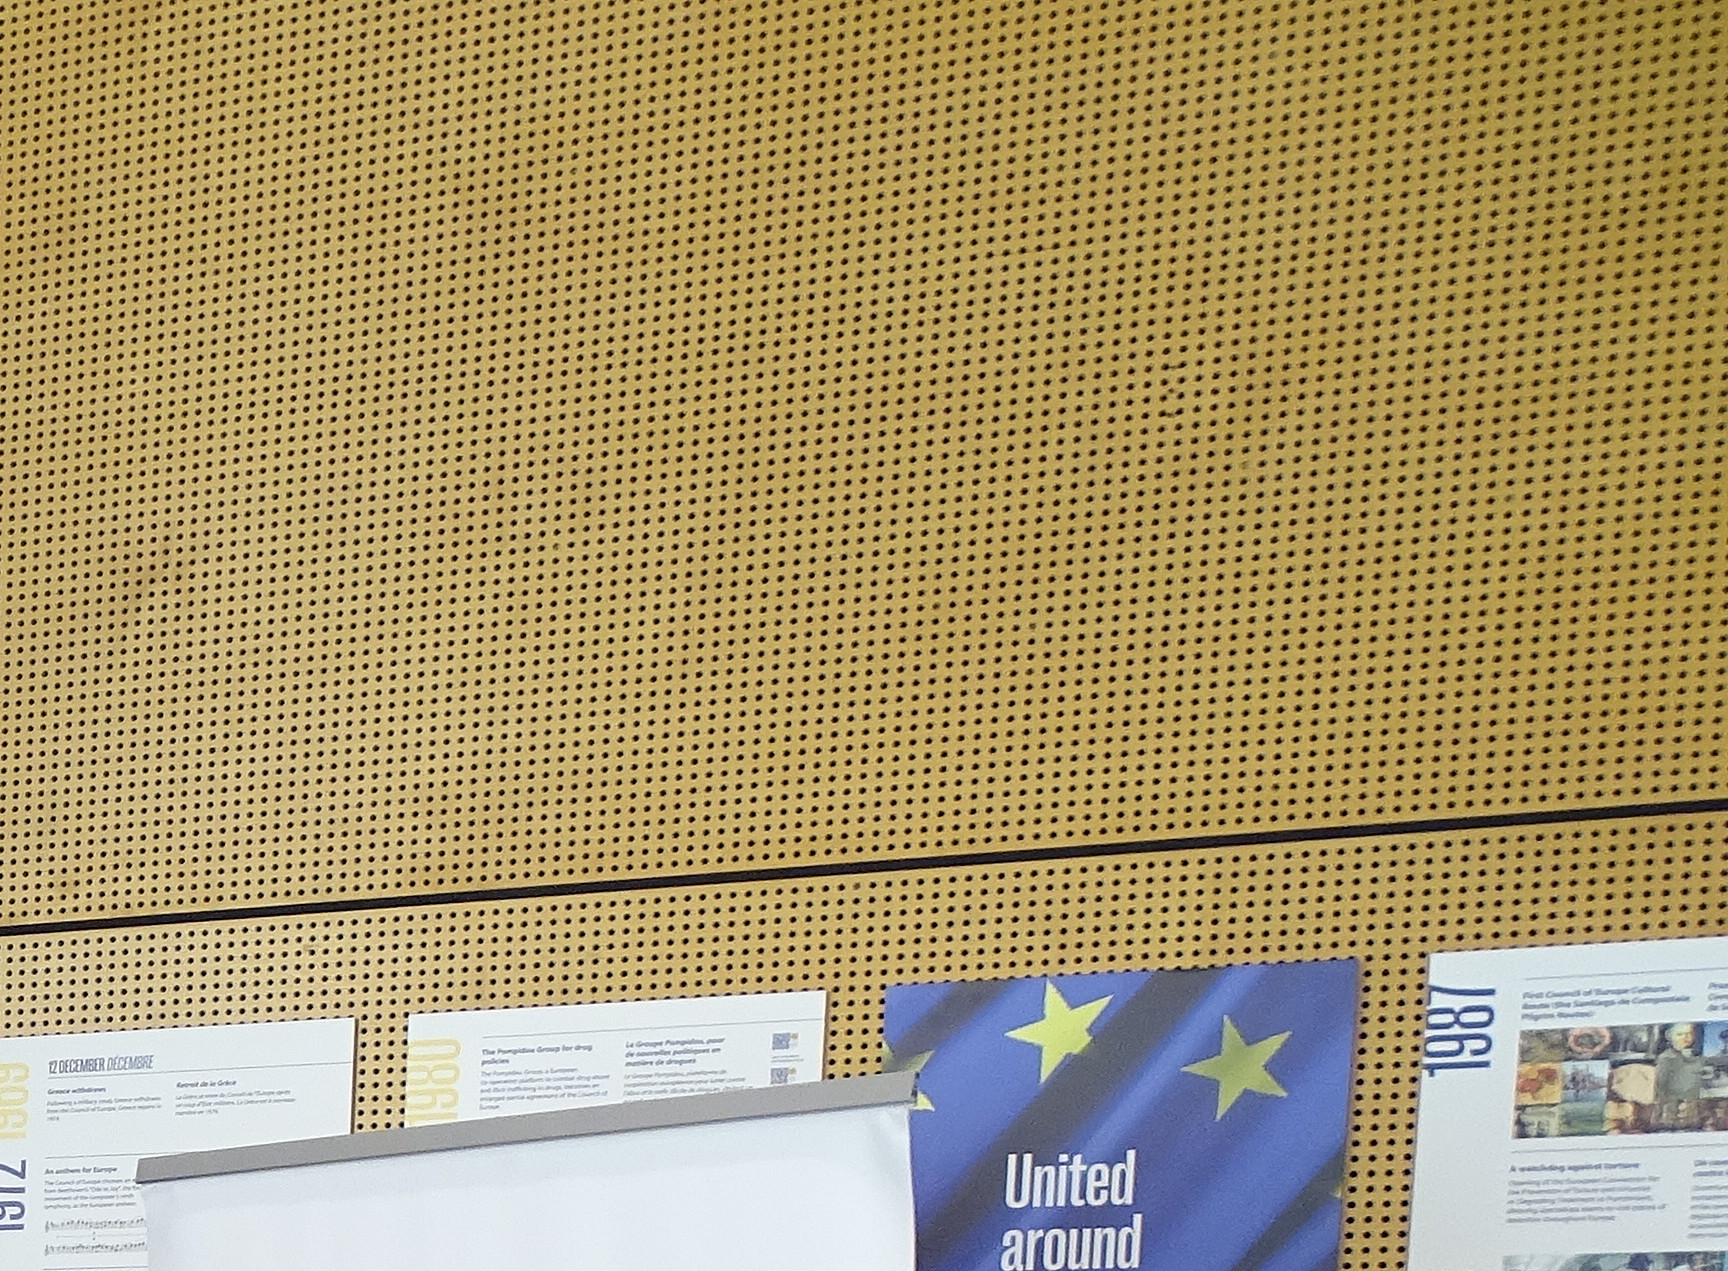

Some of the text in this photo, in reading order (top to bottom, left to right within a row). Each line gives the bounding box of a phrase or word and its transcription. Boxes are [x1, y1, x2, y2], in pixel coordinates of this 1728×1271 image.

[1422, 984, 1496, 1077] 1987
[48, 1054, 155, 1074] 12 DECEMBER DÉCEMBRE
[1006, 1149, 1137, 1209] United
[1000, 1213, 1144, 1271] around
